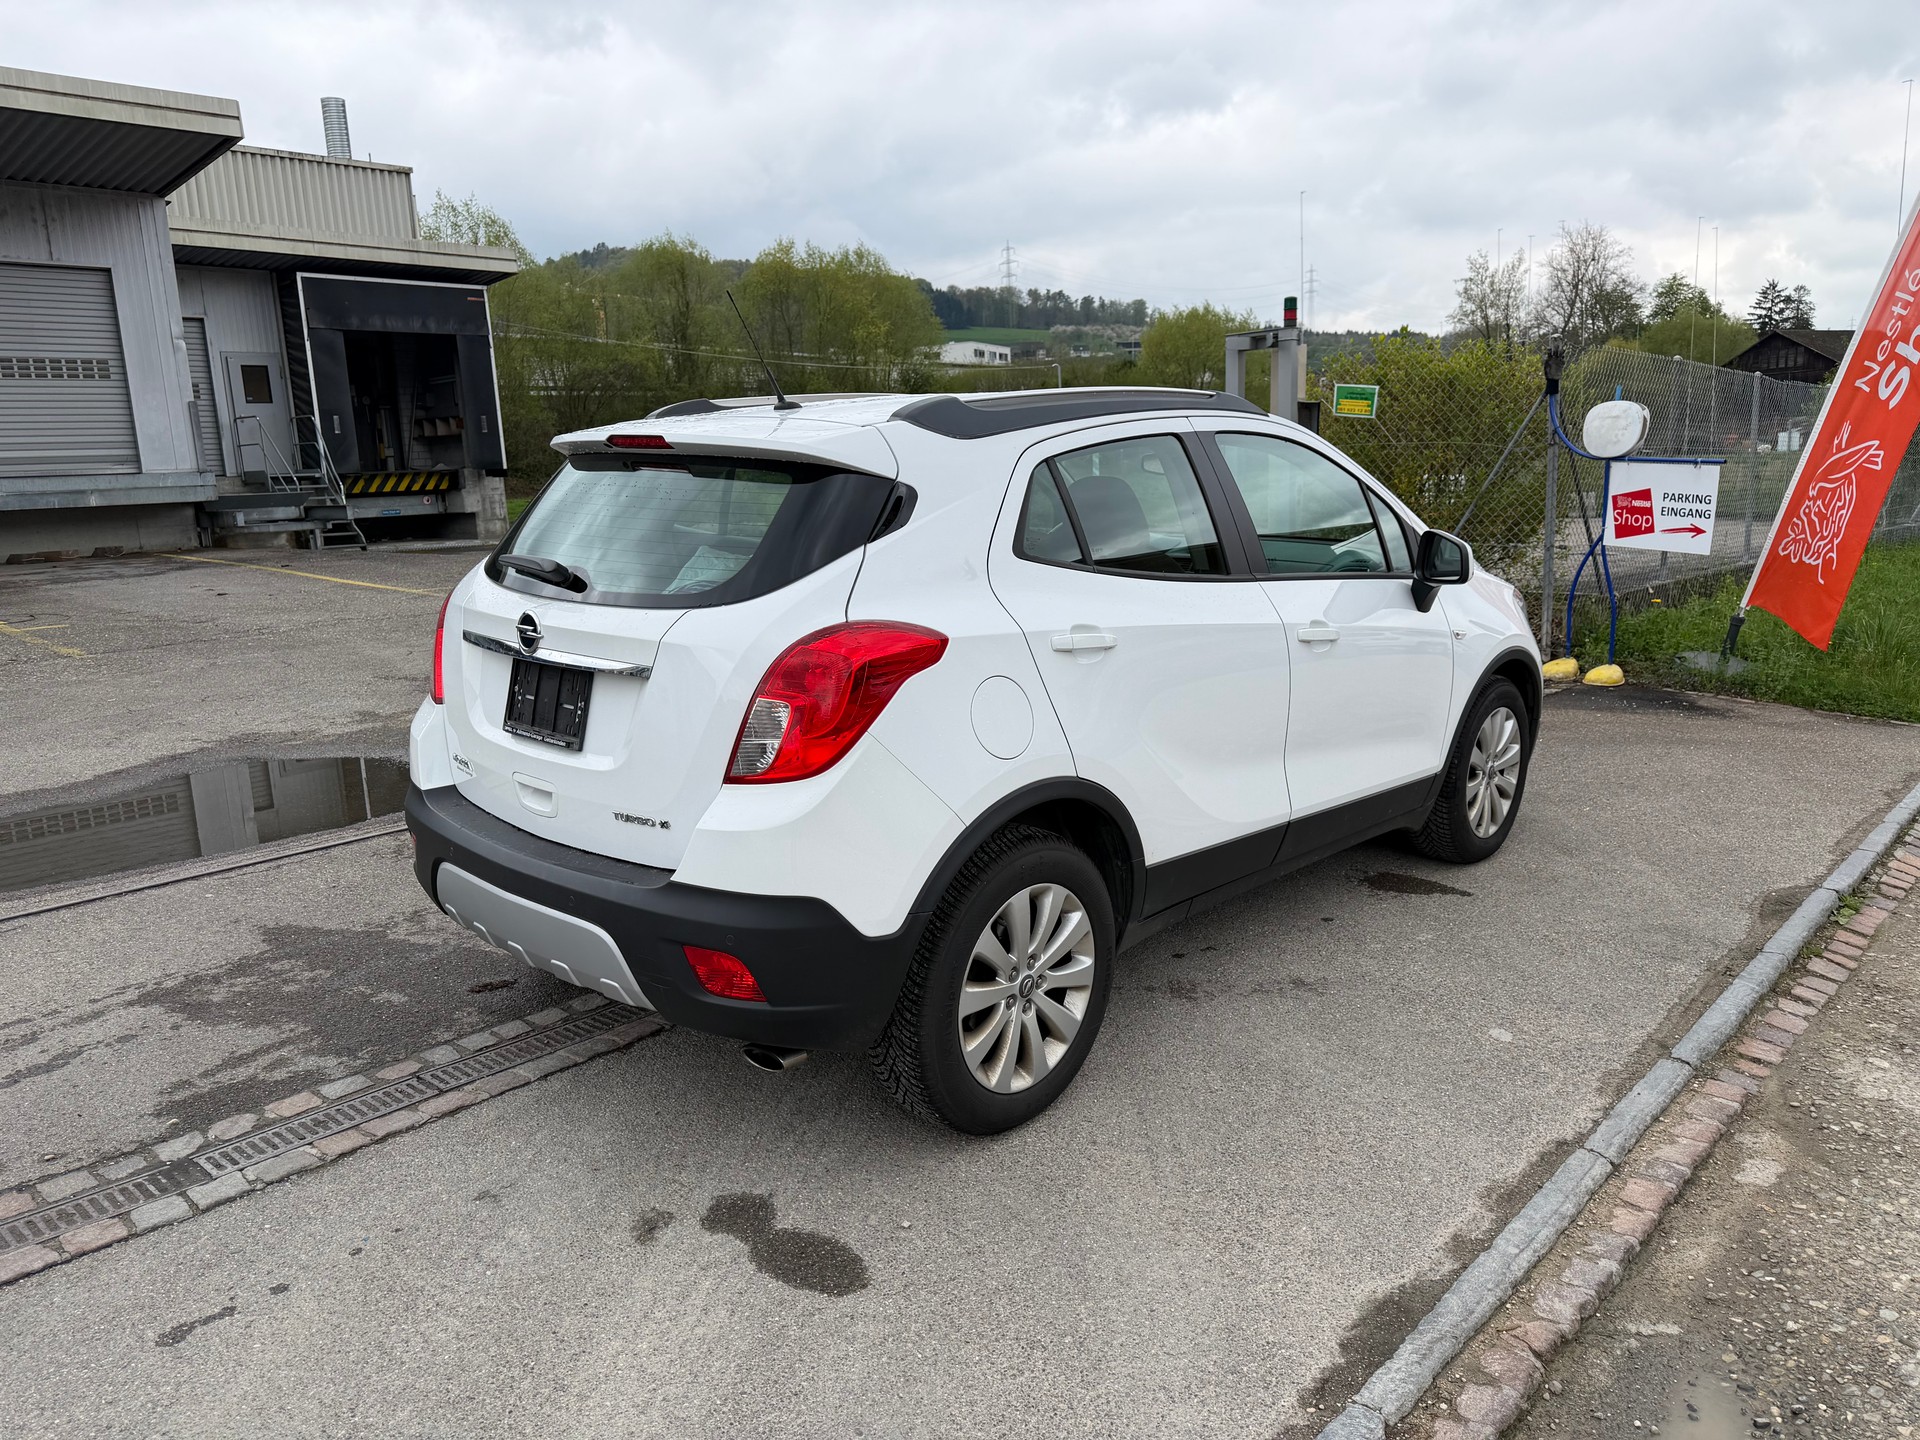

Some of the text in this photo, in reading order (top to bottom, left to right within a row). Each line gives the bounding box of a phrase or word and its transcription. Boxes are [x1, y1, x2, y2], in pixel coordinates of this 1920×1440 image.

[1854, 268, 1920, 393] Nestlé
[1662, 492, 1712, 505] PARKING
[1613, 509, 1653, 531] Shop
[1660, 506, 1712, 520] EINGANG
[611, 810, 657, 828] TURBO
